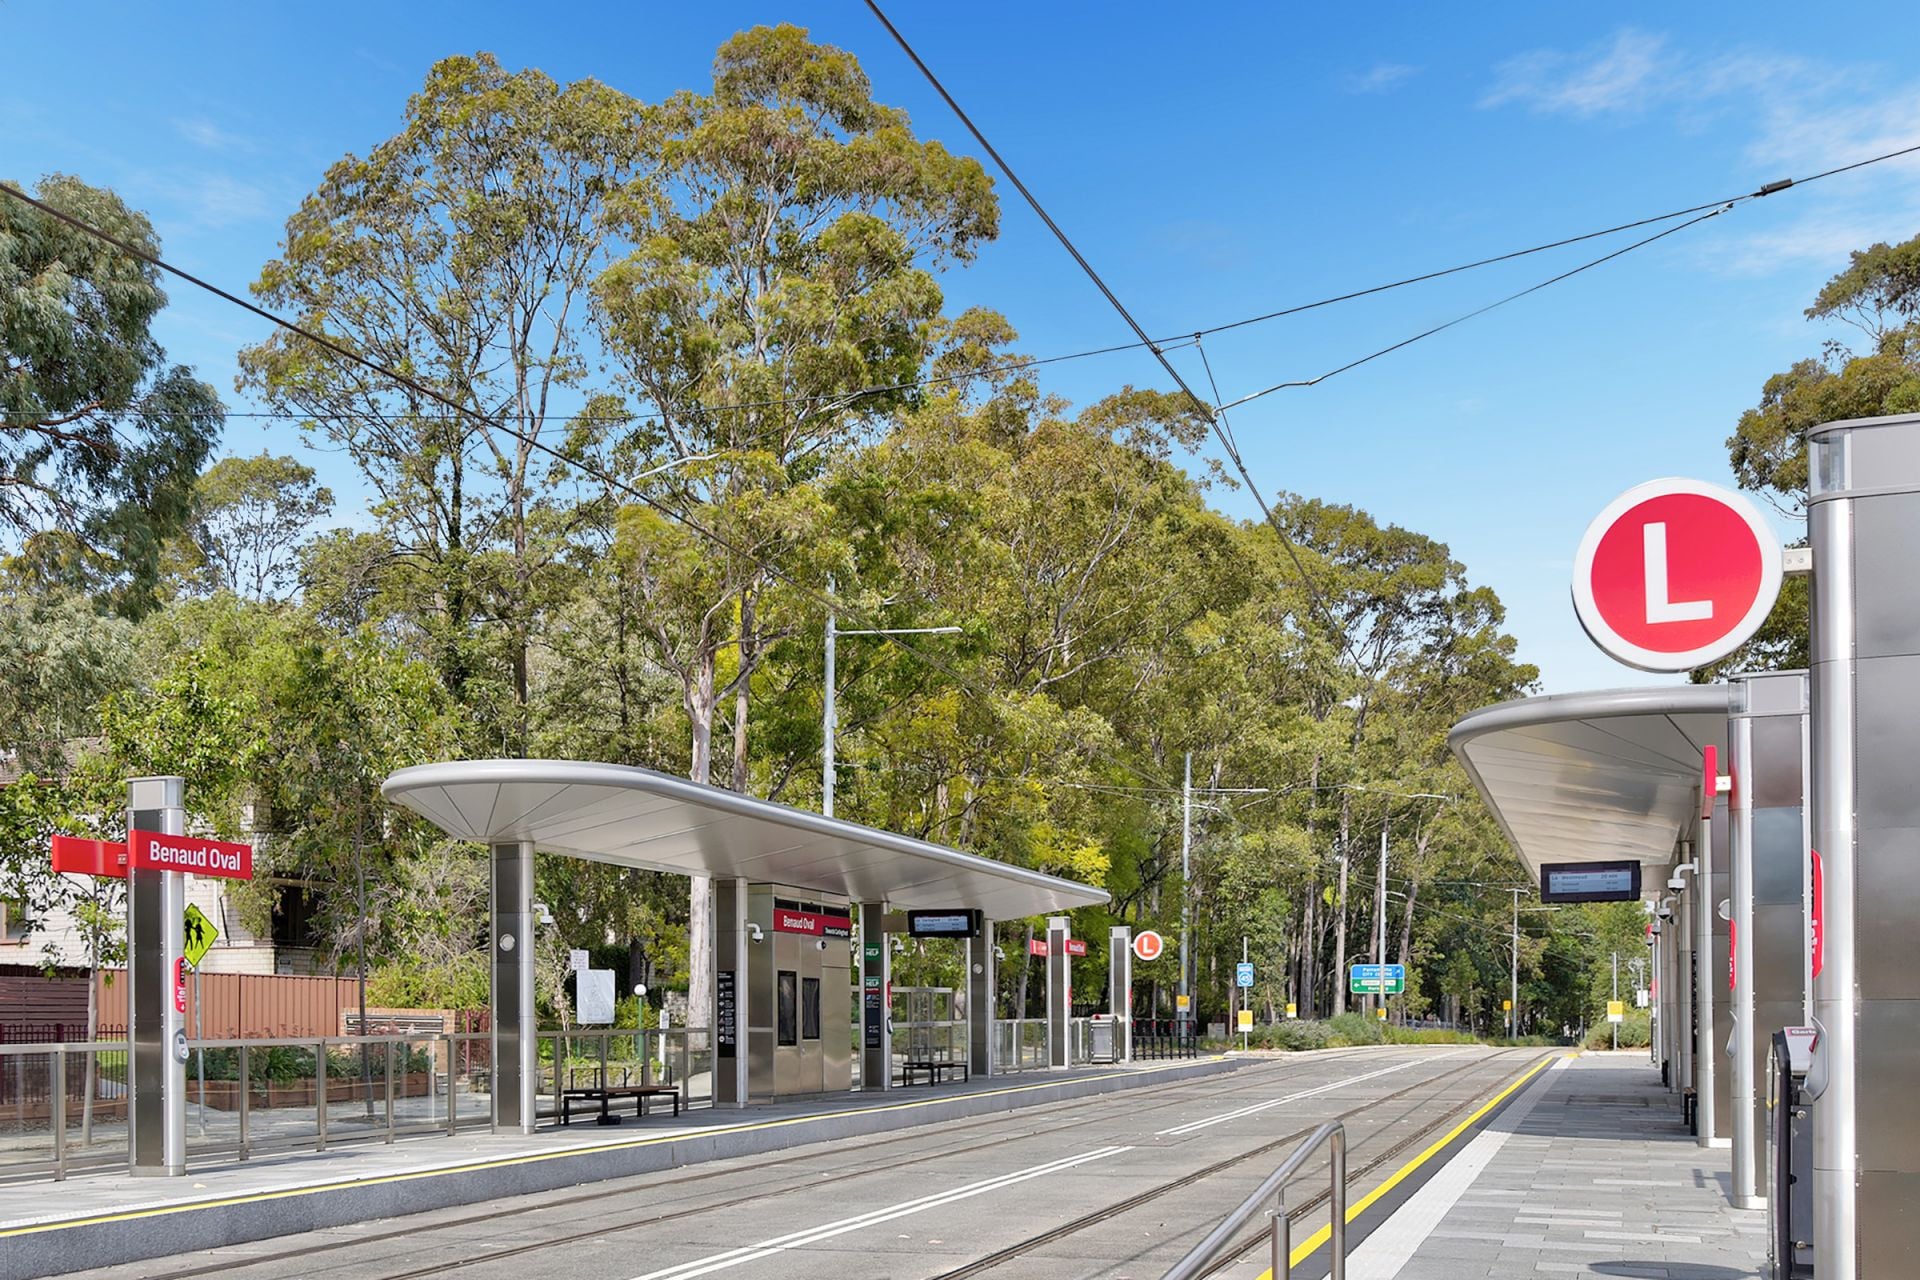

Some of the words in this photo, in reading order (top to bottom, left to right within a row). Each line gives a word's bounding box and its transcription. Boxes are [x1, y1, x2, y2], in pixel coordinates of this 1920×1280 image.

[1643, 522, 1713, 624] L
[150, 840, 207, 867] Benaud
[209, 848, 240, 871] Oval
[783, 914, 803, 929] Benaud
[803, 916, 815, 930] Oval
[1143, 937, 1154, 954] L
